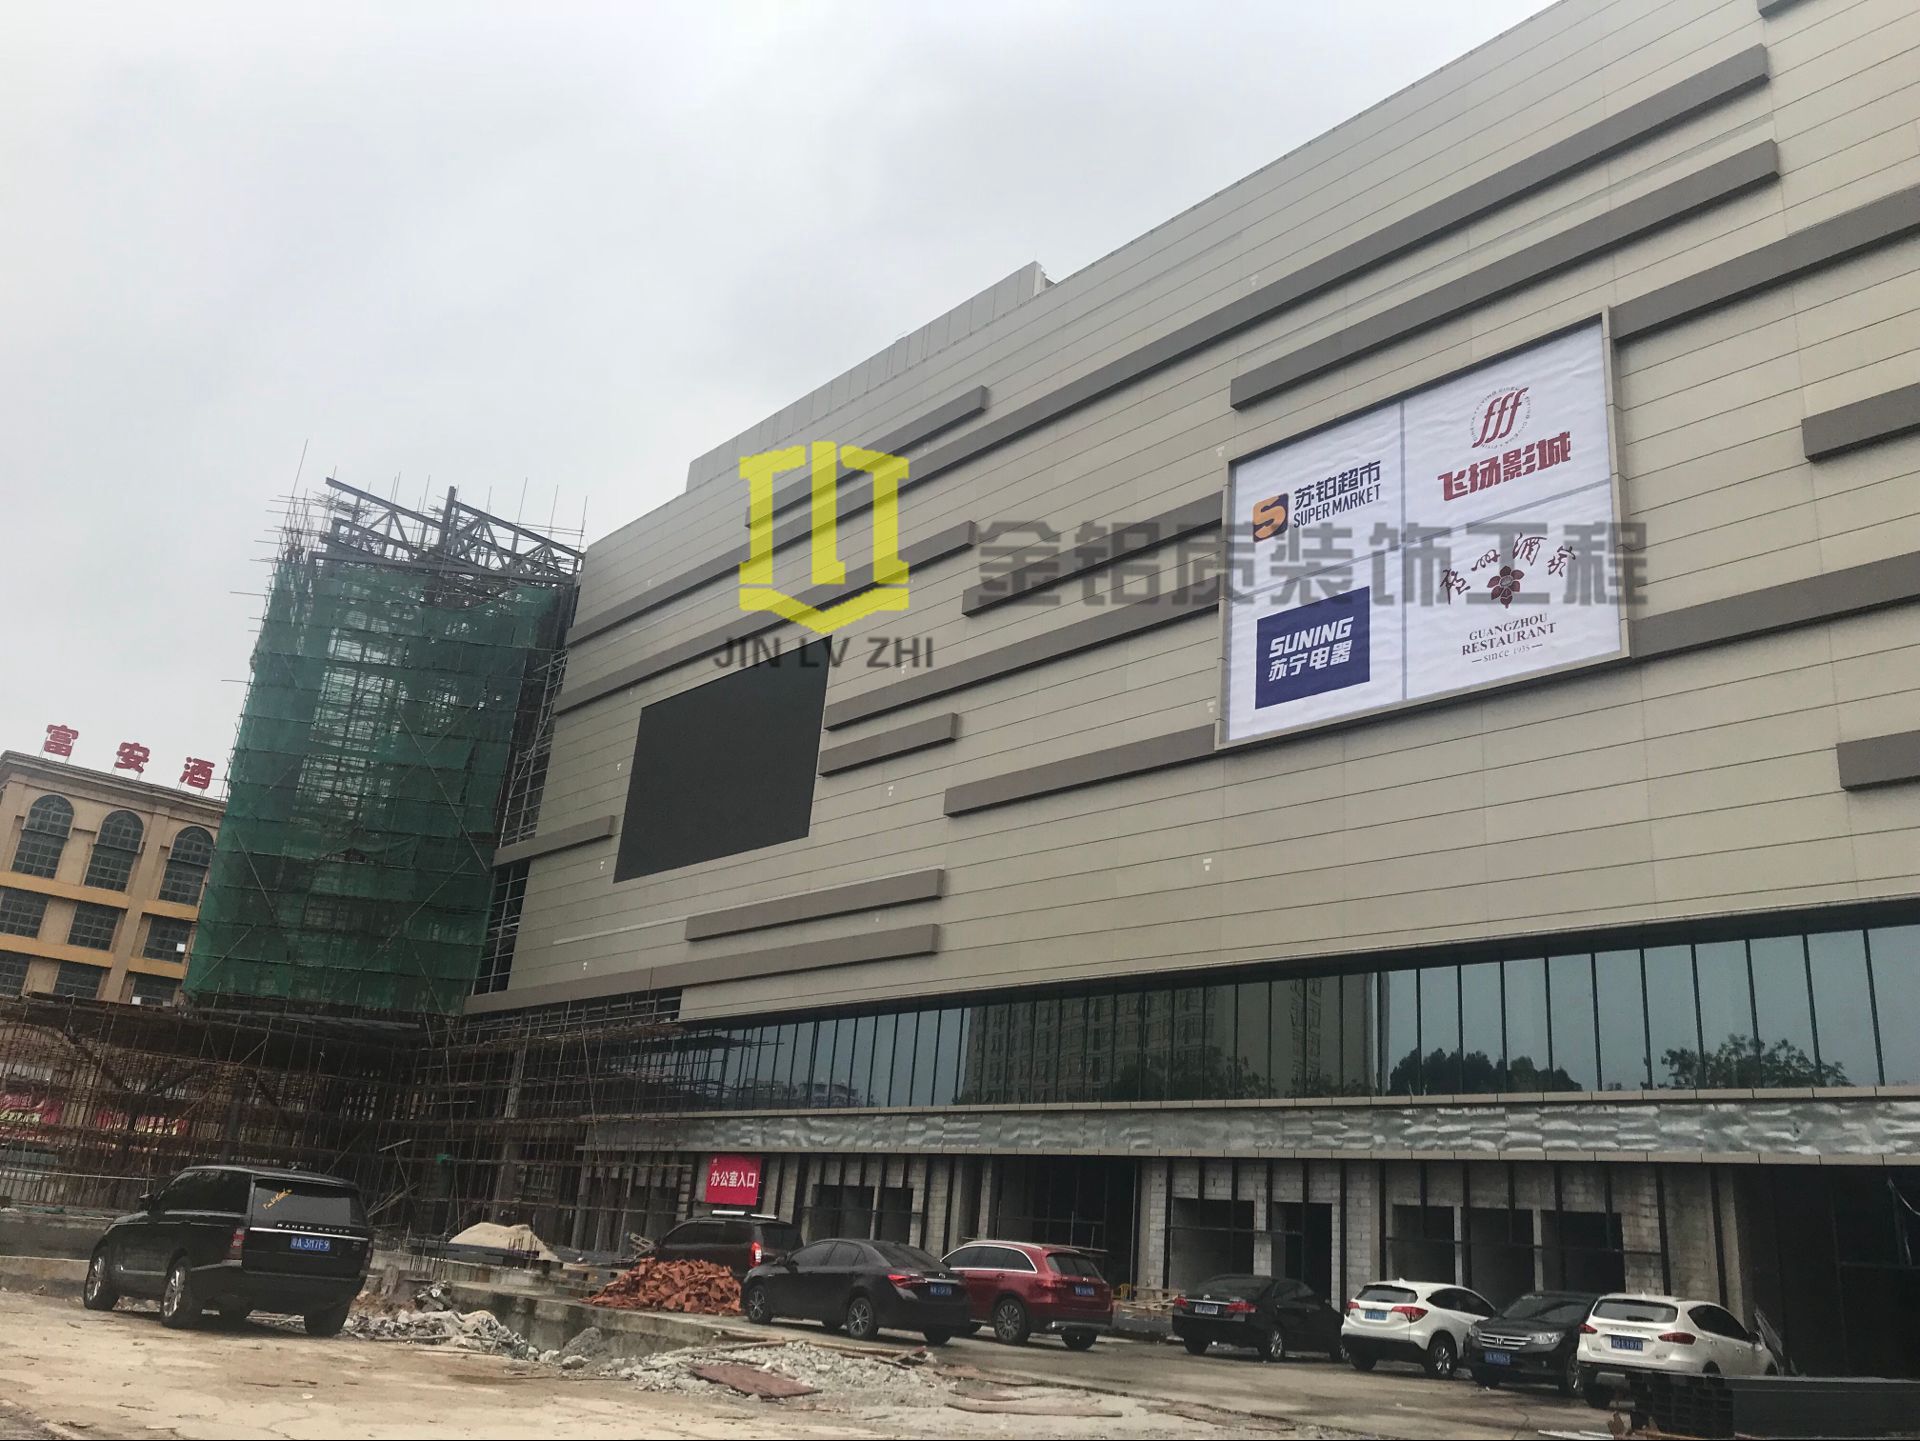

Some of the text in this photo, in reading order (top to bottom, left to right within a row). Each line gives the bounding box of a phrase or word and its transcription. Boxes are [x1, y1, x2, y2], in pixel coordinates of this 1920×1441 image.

[1294, 460, 1381, 511] 苏铂超市
[1437, 431, 1571, 501] 飞扬影城
[1293, 484, 1381, 528] SUPER MARKET
[1268, 616, 1354, 658] SUNING
[1462, 622, 1557, 656] RESTAURANT
[1469, 612, 1549, 641] GUANGZHOU
[1268, 639, 1353, 682] 苏宁电器
[710, 1170, 756, 1189] 办公室入口
